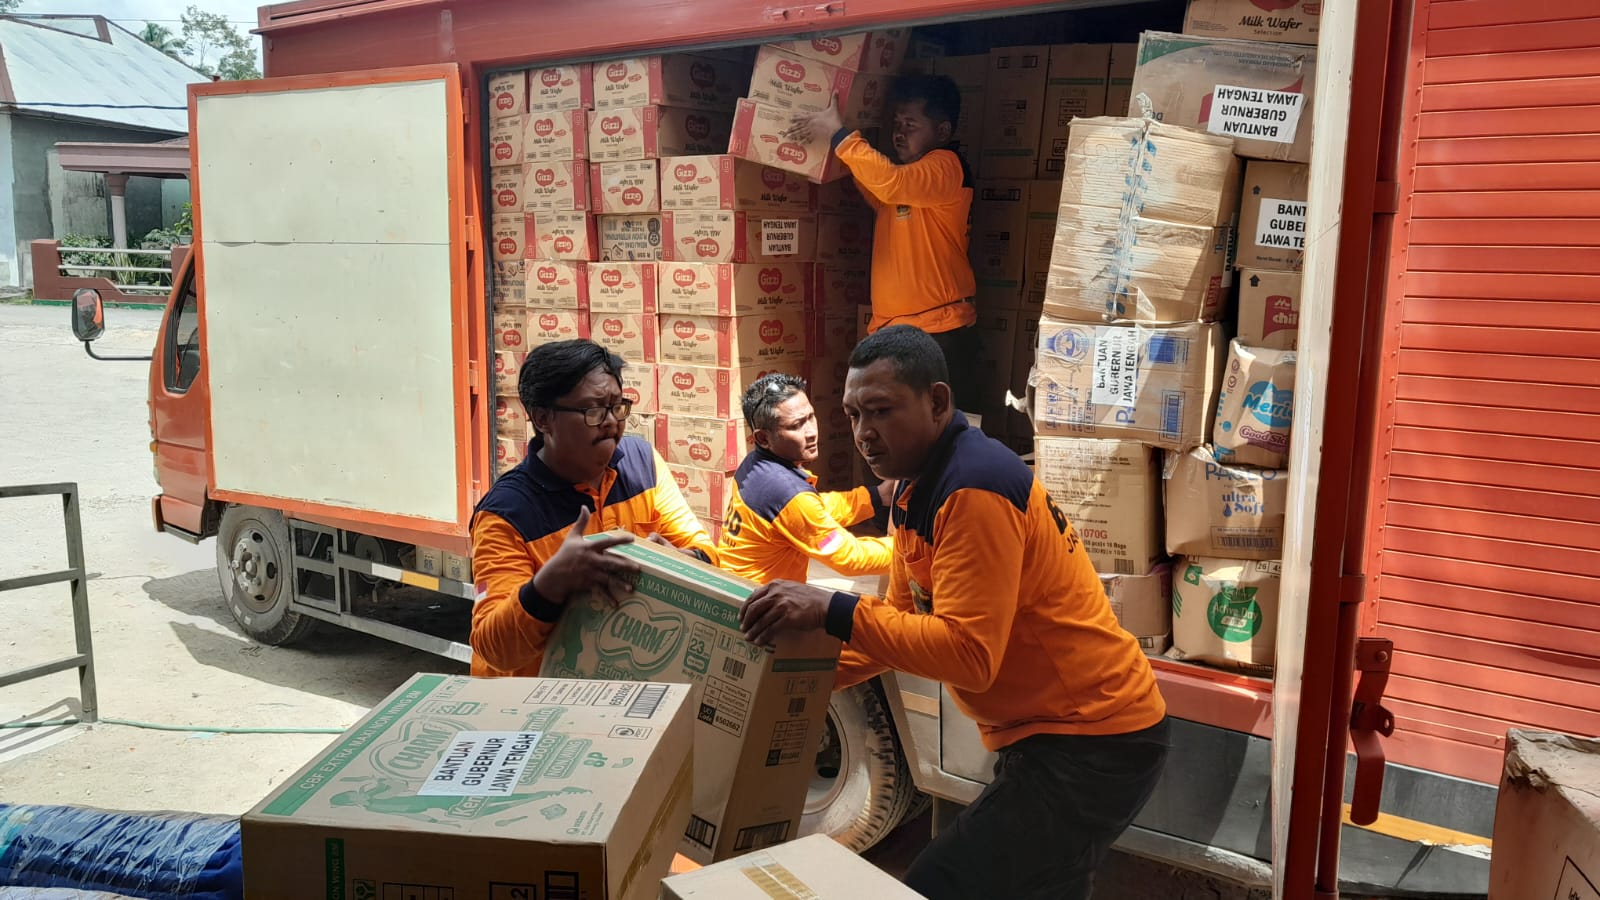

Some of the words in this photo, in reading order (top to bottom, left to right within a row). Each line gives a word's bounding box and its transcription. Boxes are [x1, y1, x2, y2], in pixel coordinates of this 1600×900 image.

[1239, 16, 1264, 27] Milk
[1266, 17, 1303, 31] Wafer
[607, 67, 626, 78] Gizzi
[780, 63, 801, 78] Gizzi
[1217, 88, 1263, 101] TENGAH
[1266, 93, 1299, 106] JAWA
[1220, 105, 1287, 122] GUBERNUR
[536, 122, 552, 133] Gizzi
[602, 121, 620, 131] Gizzi
[1223, 121, 1279, 137] BANTUAN
[781, 146, 806, 160] Gizzi
[536, 172, 553, 182] Gizzi
[676, 167, 695, 177] Gizzi
[763, 221, 782, 229] TENGAH
[1270, 218, 1305, 232] GUBE
[767, 232, 794, 240] GUBERNUR
[1260, 233, 1291, 247] JAWA
[675, 272, 693, 281] Gizzi
[675, 325, 693, 334] Gizzi
[1125, 330, 1137, 372] TENGAH
[1096, 339, 1108, 390] BANTUAN
[1109, 335, 1122, 395] GUBERNUR
[673, 376, 692, 385] Gizzi
[1122, 375, 1134, 402] JAWA
[1241, 426, 1270, 440] Good
[1205, 462, 1278, 482] PAO
[1222, 490, 1256, 503] ultra
[1233, 502, 1265, 516] Soft
[646, 577, 670, 597] MAXI
[670, 586, 692, 605] NON
[693, 597, 719, 617] WING
[1212, 601, 1239, 617] Active
[1240, 606, 1258, 622] Day
[610, 611, 678, 655] CHARM
[689, 637, 705, 653] 23
[299, 769, 327, 790] CBF
[322, 745, 353, 773] EXTRA
[352, 727, 376, 748] MAXI
[375, 711, 393, 730] NON
[388, 721, 454, 771] CHARM
[434, 741, 476, 782] BANTUAN
[462, 737, 506, 786] GUBERNUR
[488, 763, 514, 792] JAWA
[502, 733, 537, 767] TENGAH
[583, 752, 608, 768] 8P
